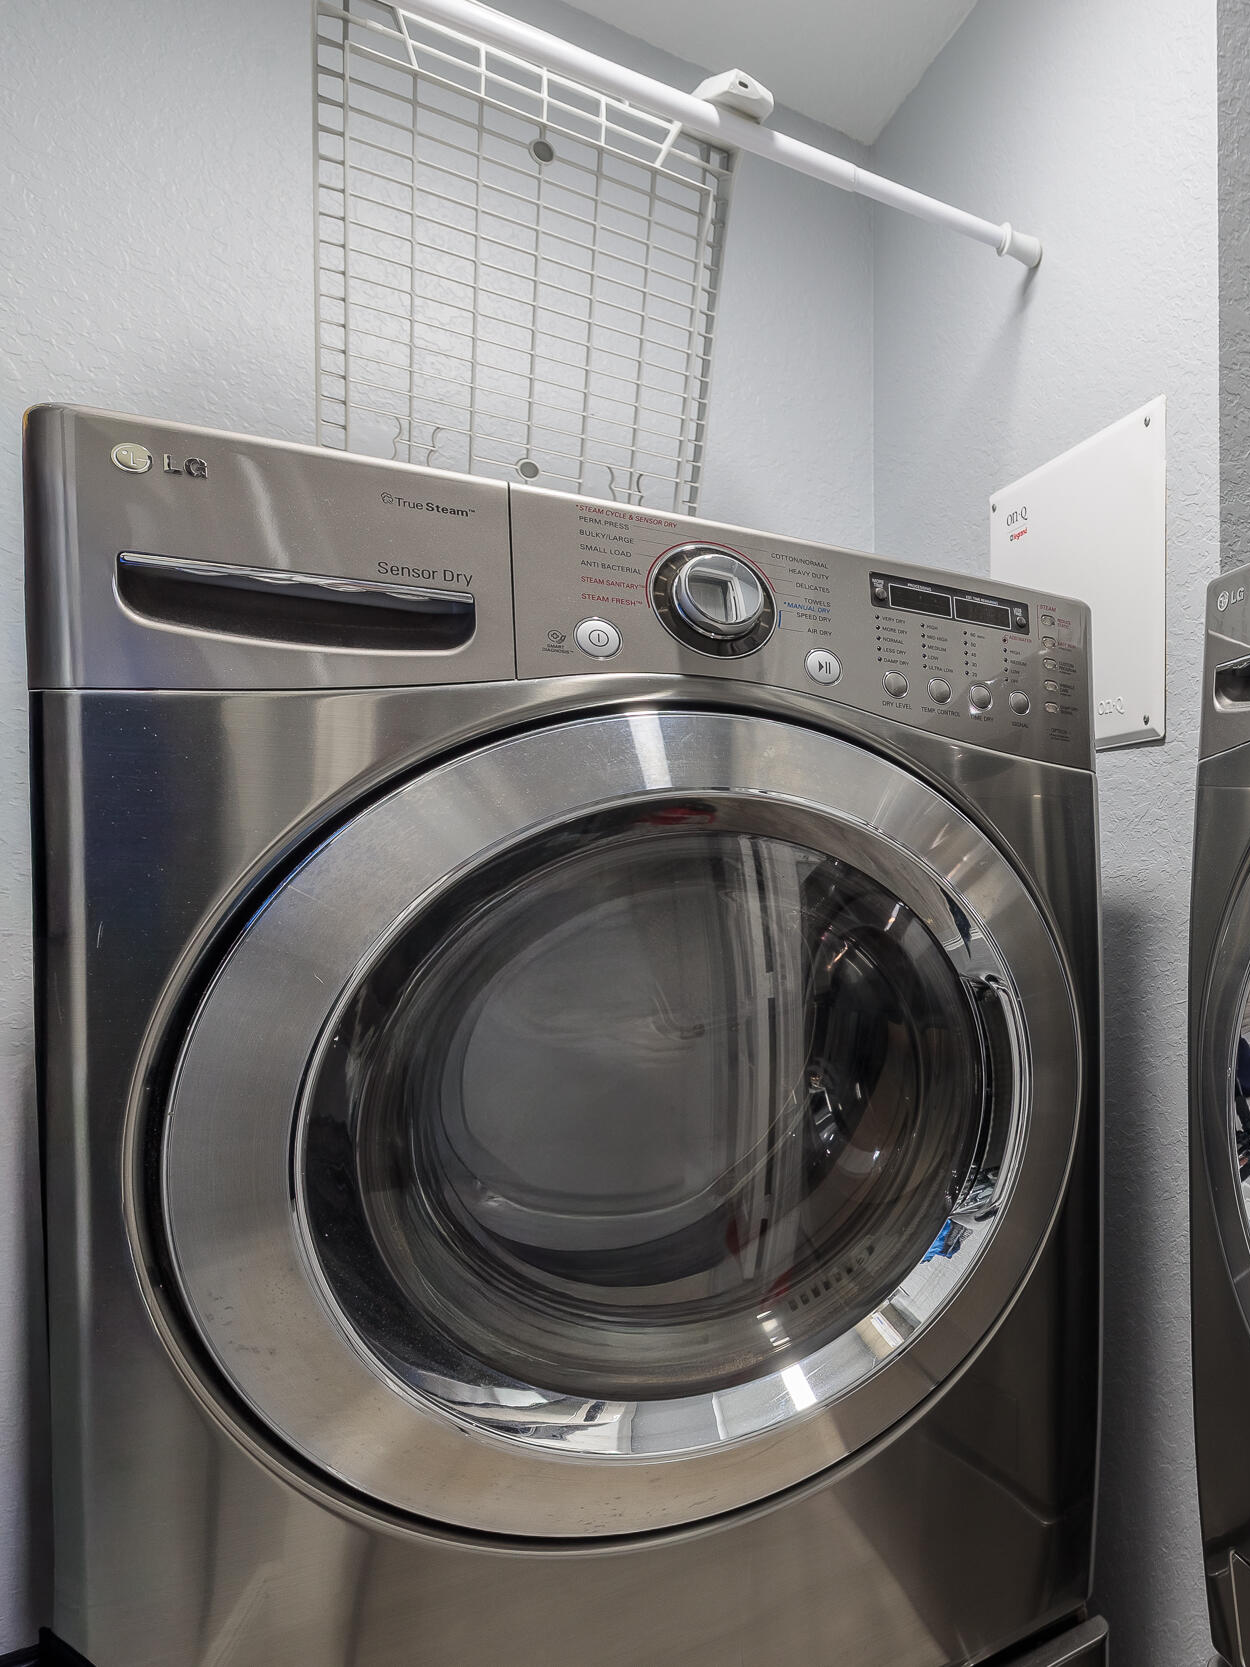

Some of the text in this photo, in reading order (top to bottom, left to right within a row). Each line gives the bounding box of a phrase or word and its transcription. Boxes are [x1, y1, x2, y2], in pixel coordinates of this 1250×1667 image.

[162, 454, 209, 480] LG
[579, 505, 604, 515] STEAM
[606, 510, 627, 519] CYCLE
[635, 516, 662, 526] SENSOR
[604, 520, 630, 530] PRESS
[579, 529, 634, 544] BULKY/LARGE
[580, 544, 632, 558] SMALL LOAD
[771, 552, 829, 569] COTTON/NORMAL
[580, 560, 642, 575] ANTI BACTERIAL
[788, 568, 810, 576] HEAVY
[377, 561, 473, 587] Sensor Dry
[580, 576, 605, 585] STEAM
[795, 582, 830, 594] DELICATES
[581, 593, 609, 603] STEAM
[1230, 586, 1245, 604] LG
[787, 602, 818, 612] MANUAL
[804, 597, 831, 607] TOWELS
[796, 612, 817, 621] SPEED
[927, 644, 947, 652] MEDIUM
[895, 702, 912, 710] LEVEL
[936, 708, 961, 718] CONTROL
[1011, 721, 1029, 729] SIGNAL
